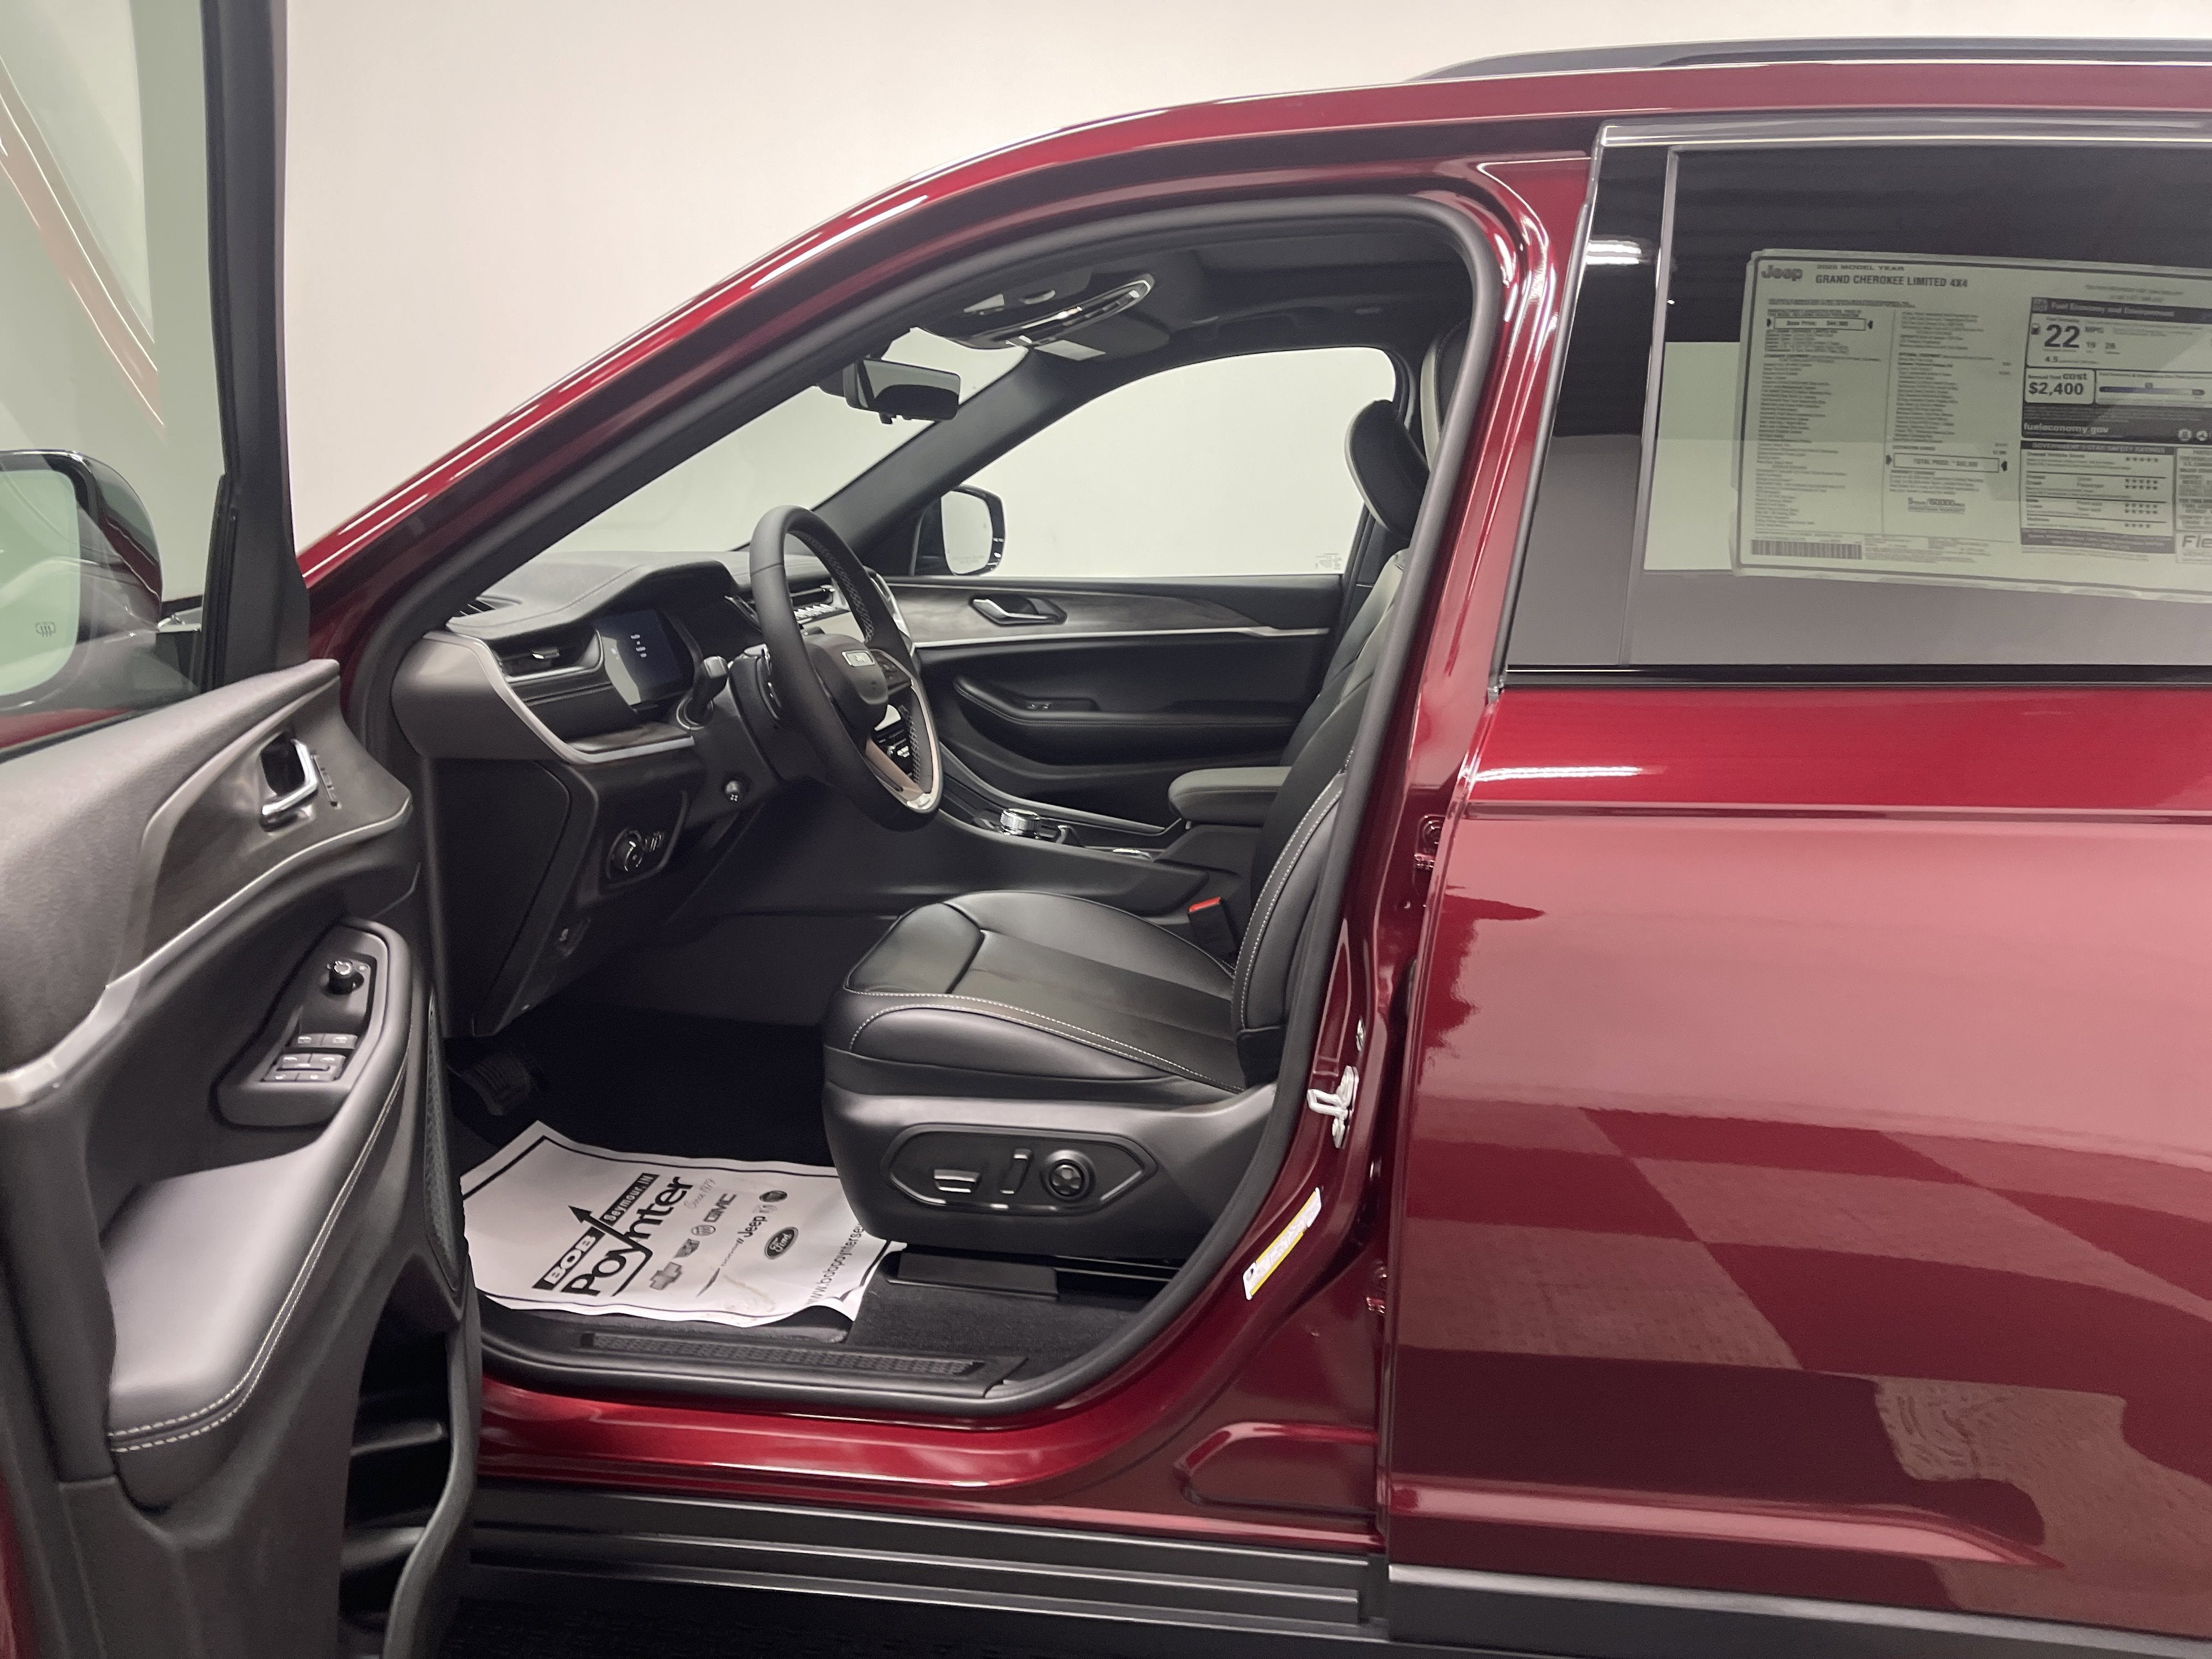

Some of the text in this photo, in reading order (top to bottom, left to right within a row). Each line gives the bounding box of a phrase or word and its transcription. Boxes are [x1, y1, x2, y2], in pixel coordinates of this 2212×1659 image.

[1761, 264, 1803, 282] Jeep
[1815, 274, 1850, 284] GRAND
[1853, 275, 1904, 285] CHEROKEE
[1907, 276, 1947, 287] LIMITED
[2044, 324, 2080, 348] 22
[2028, 382, 2084, 396] $2,400
[2023, 422, 2109, 434] fueleconomy.gov
[704, 1193, 737, 1222] GMC
[560, 1176, 693, 1297] Poynter
[737, 1216, 768, 1238] Jeep
[544, 1235, 596, 1285] BOB
